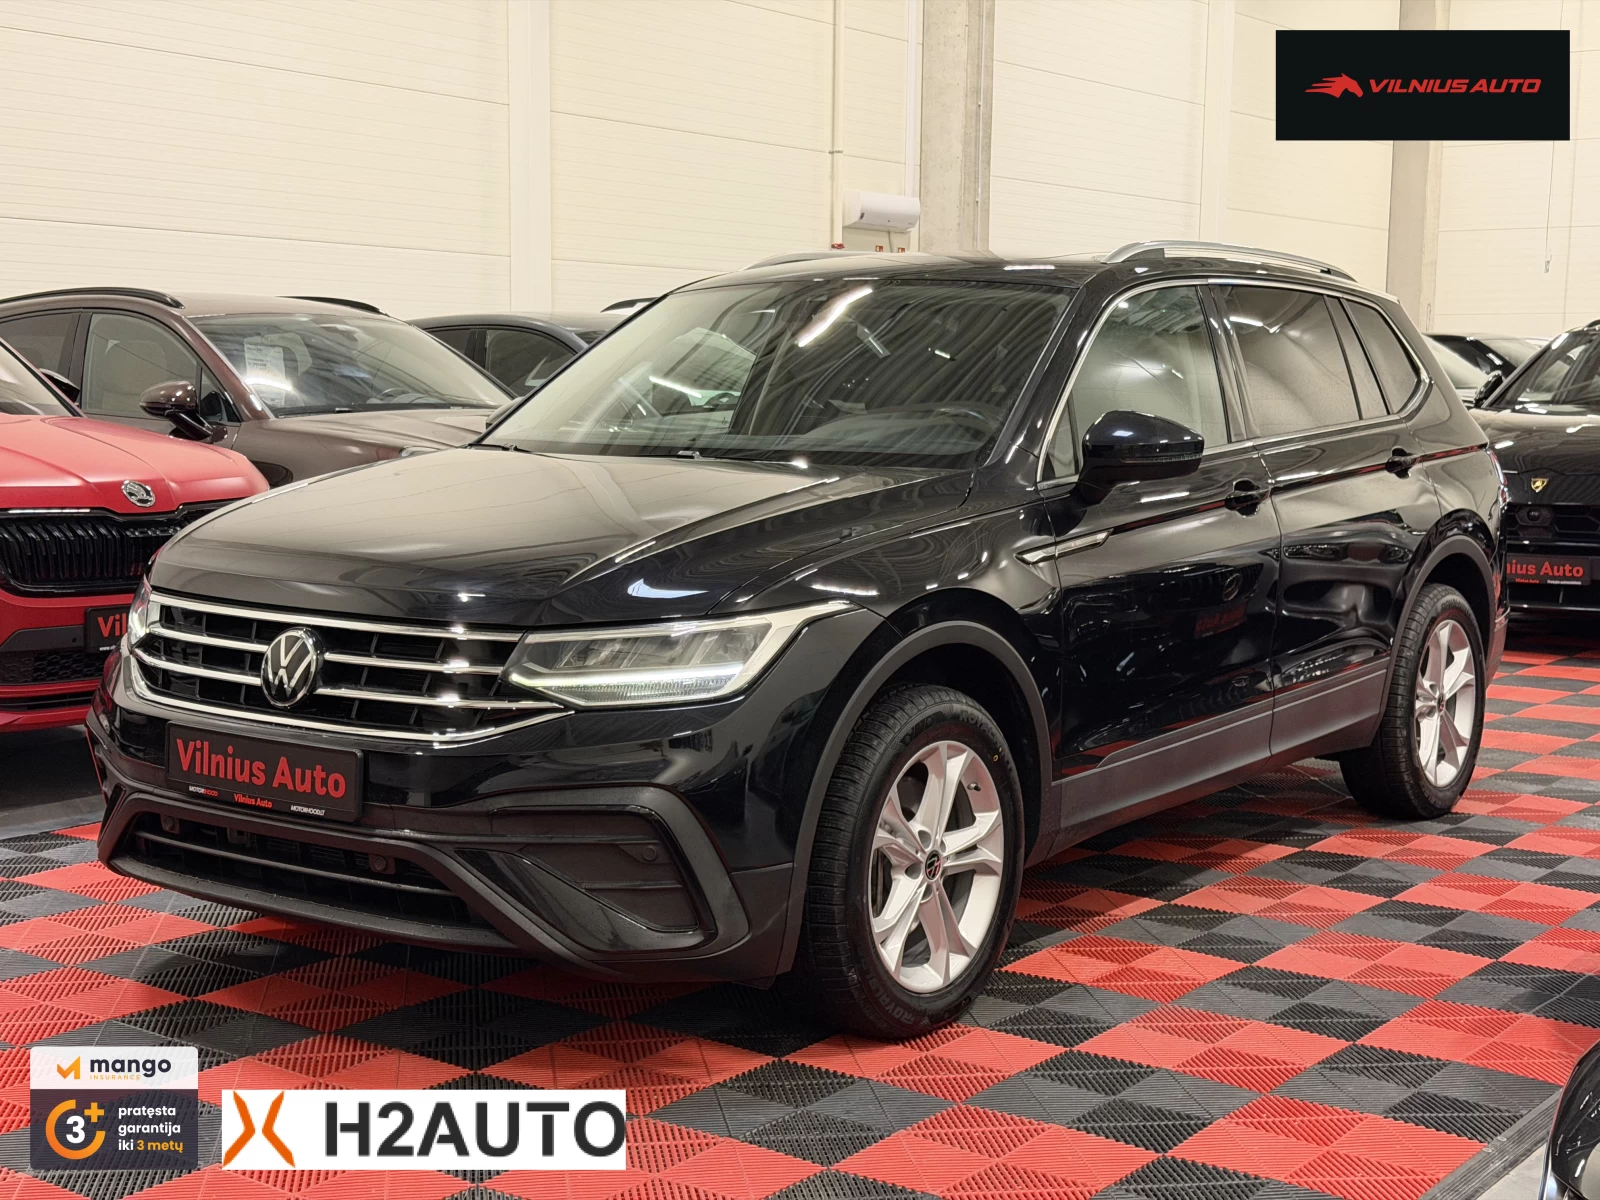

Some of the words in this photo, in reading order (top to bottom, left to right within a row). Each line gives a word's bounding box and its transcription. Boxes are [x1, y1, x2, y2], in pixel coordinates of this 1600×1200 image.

[1540, 561, 1584, 577] Auto
[176, 738, 266, 786] Vilnius
[272, 756, 346, 798] Auto
[234, 793, 256, 805] Vilnius
[256, 799, 273, 808] Auto
